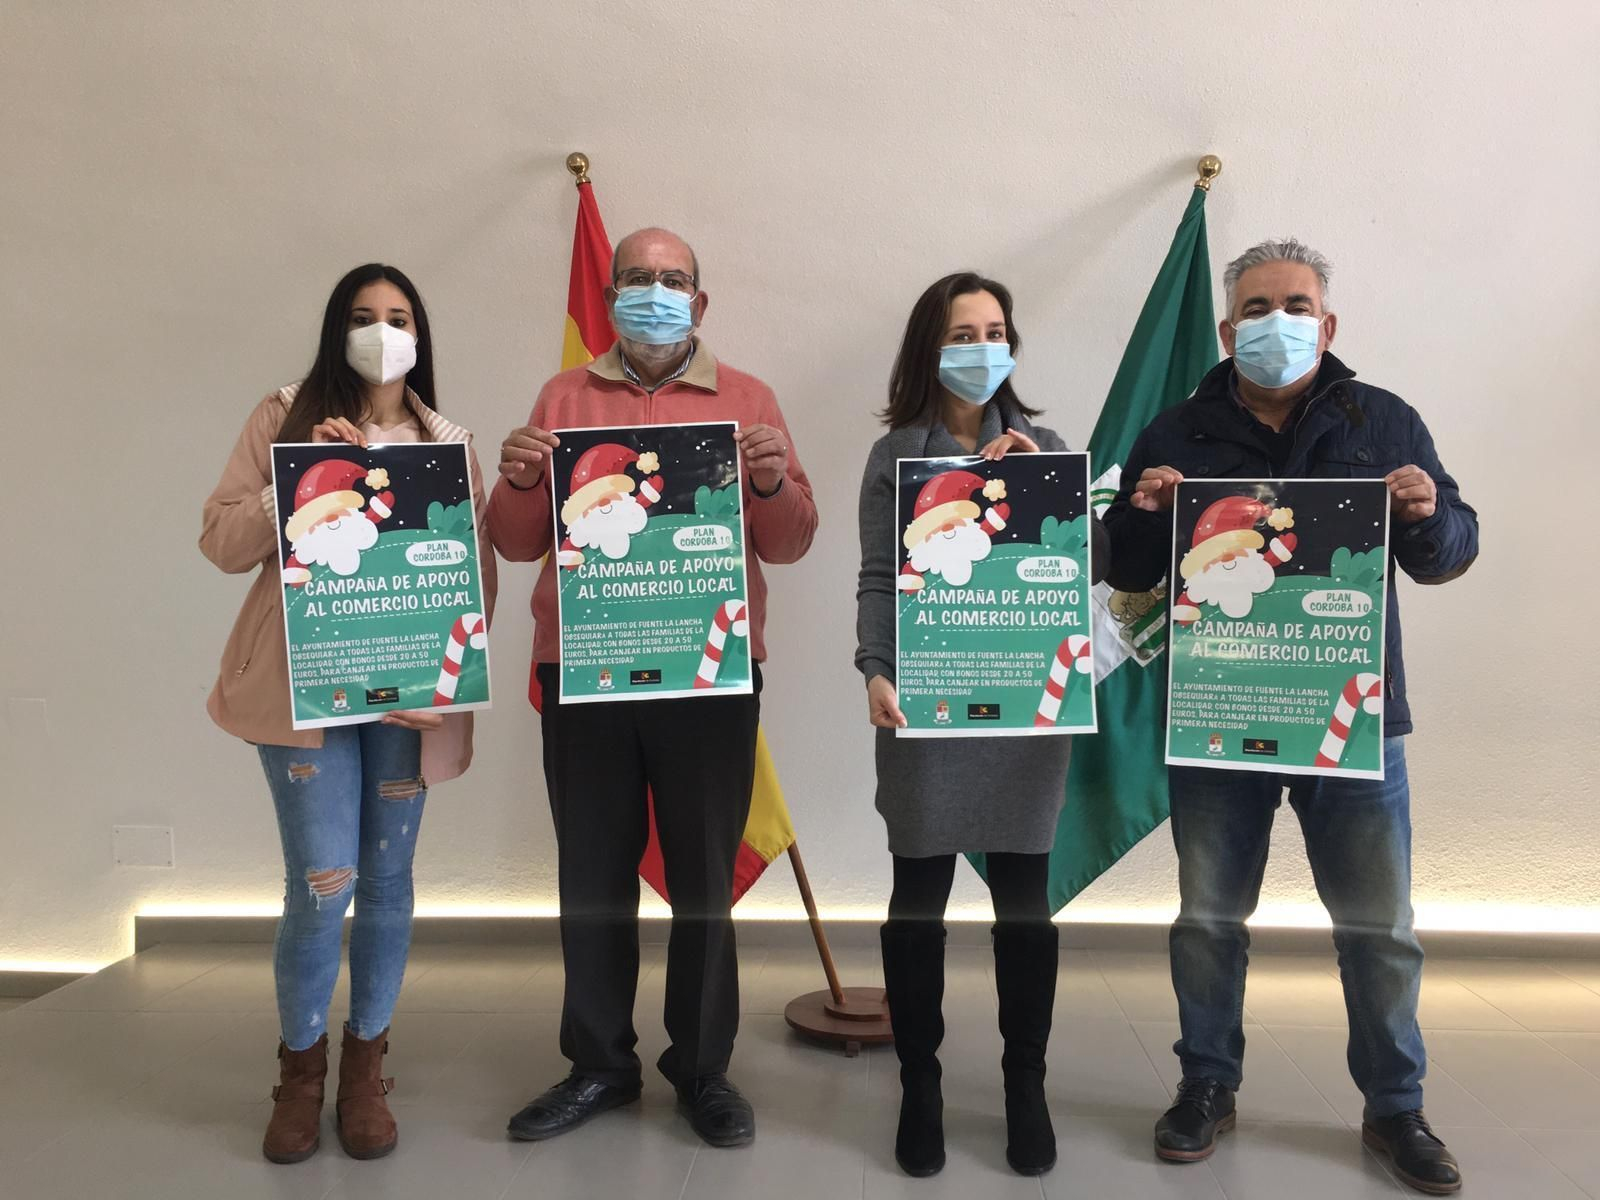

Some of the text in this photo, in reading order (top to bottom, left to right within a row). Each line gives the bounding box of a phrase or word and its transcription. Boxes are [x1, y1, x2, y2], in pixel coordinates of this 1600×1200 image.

[693, 528, 715, 537] PLAN
[426, 542, 449, 552] PLAN
[680, 537, 717, 547] CORDOBA
[413, 550, 465, 562] CORDOBA 10
[577, 556, 734, 579] CAMPAÑA DE APOYO
[1038, 559, 1060, 568] PLAN
[1024, 568, 1076, 577] CORDOBA 10
[304, 570, 470, 596] CAMPAÑA DE APOYO
[577, 576, 737, 599] AL COMERCIO LOCAL
[917, 589, 1079, 605] CAMPAÑA DE APOYO
[1326, 592, 1351, 602] PLAN
[304, 590, 474, 617] AL COMERCIO LOCAL
[1310, 602, 1369, 612] CORDOBA 10
[916, 610, 1081, 626] AL COMERCIO LOCAL
[573, 622, 627, 632] AYUNTAMIENTO
[638, 620, 663, 628] FUENTE
[675, 617, 703, 626] LANCHA
[652, 627, 684, 636] FAMILIAS
[1192, 620, 1371, 642] CAMPAÑA DE APOYO
[302, 639, 360, 651] AYUNTAMIENTO
[372, 635, 398, 644] FUENTE
[410, 632, 439, 641] LANCHA
[347, 647, 370, 656] TODAS
[371, 646, 385, 654] LAS
[386, 642, 420, 652] FAMILIAS
[609, 647, 641, 655] CANJEAR
[653, 644, 692, 653] PRODUCTOS
[1190, 641, 1373, 664] AL COMERCIO LOCAL
[335, 658, 350, 666] CON
[351, 656, 375, 664] BONOS
[377, 654, 398, 662] DESDE
[598, 656, 634, 664] NECESIDAD
[320, 668, 341, 676] PARA
[342, 664, 376, 674] CANJEAR
[388, 660, 430, 670] PRODUCTOS
[294, 674, 370, 687] PRIMERA NECESIDAD
[1184, 682, 1243, 692] AYUNTAMIENTO
[1255, 686, 1283, 694] FUENTE
[1297, 688, 1329, 696] LANCHA
[1228, 694, 1252, 702] TODAS
[1254, 695, 1268, 703] LAS
[1269, 696, 1306, 705] FAMILIAS
[1319, 698, 1330, 706] LA
[1232, 703, 1256, 712] BONOS
[1258, 705, 1280, 713] DESDE
[1199, 711, 1219, 719] PARA
[1221, 712, 1256, 721] CANJEAR
[1270, 715, 1315, 724] PRODUCTOS
[1172, 718, 1248, 730] PRIMERA NECESIDAD
